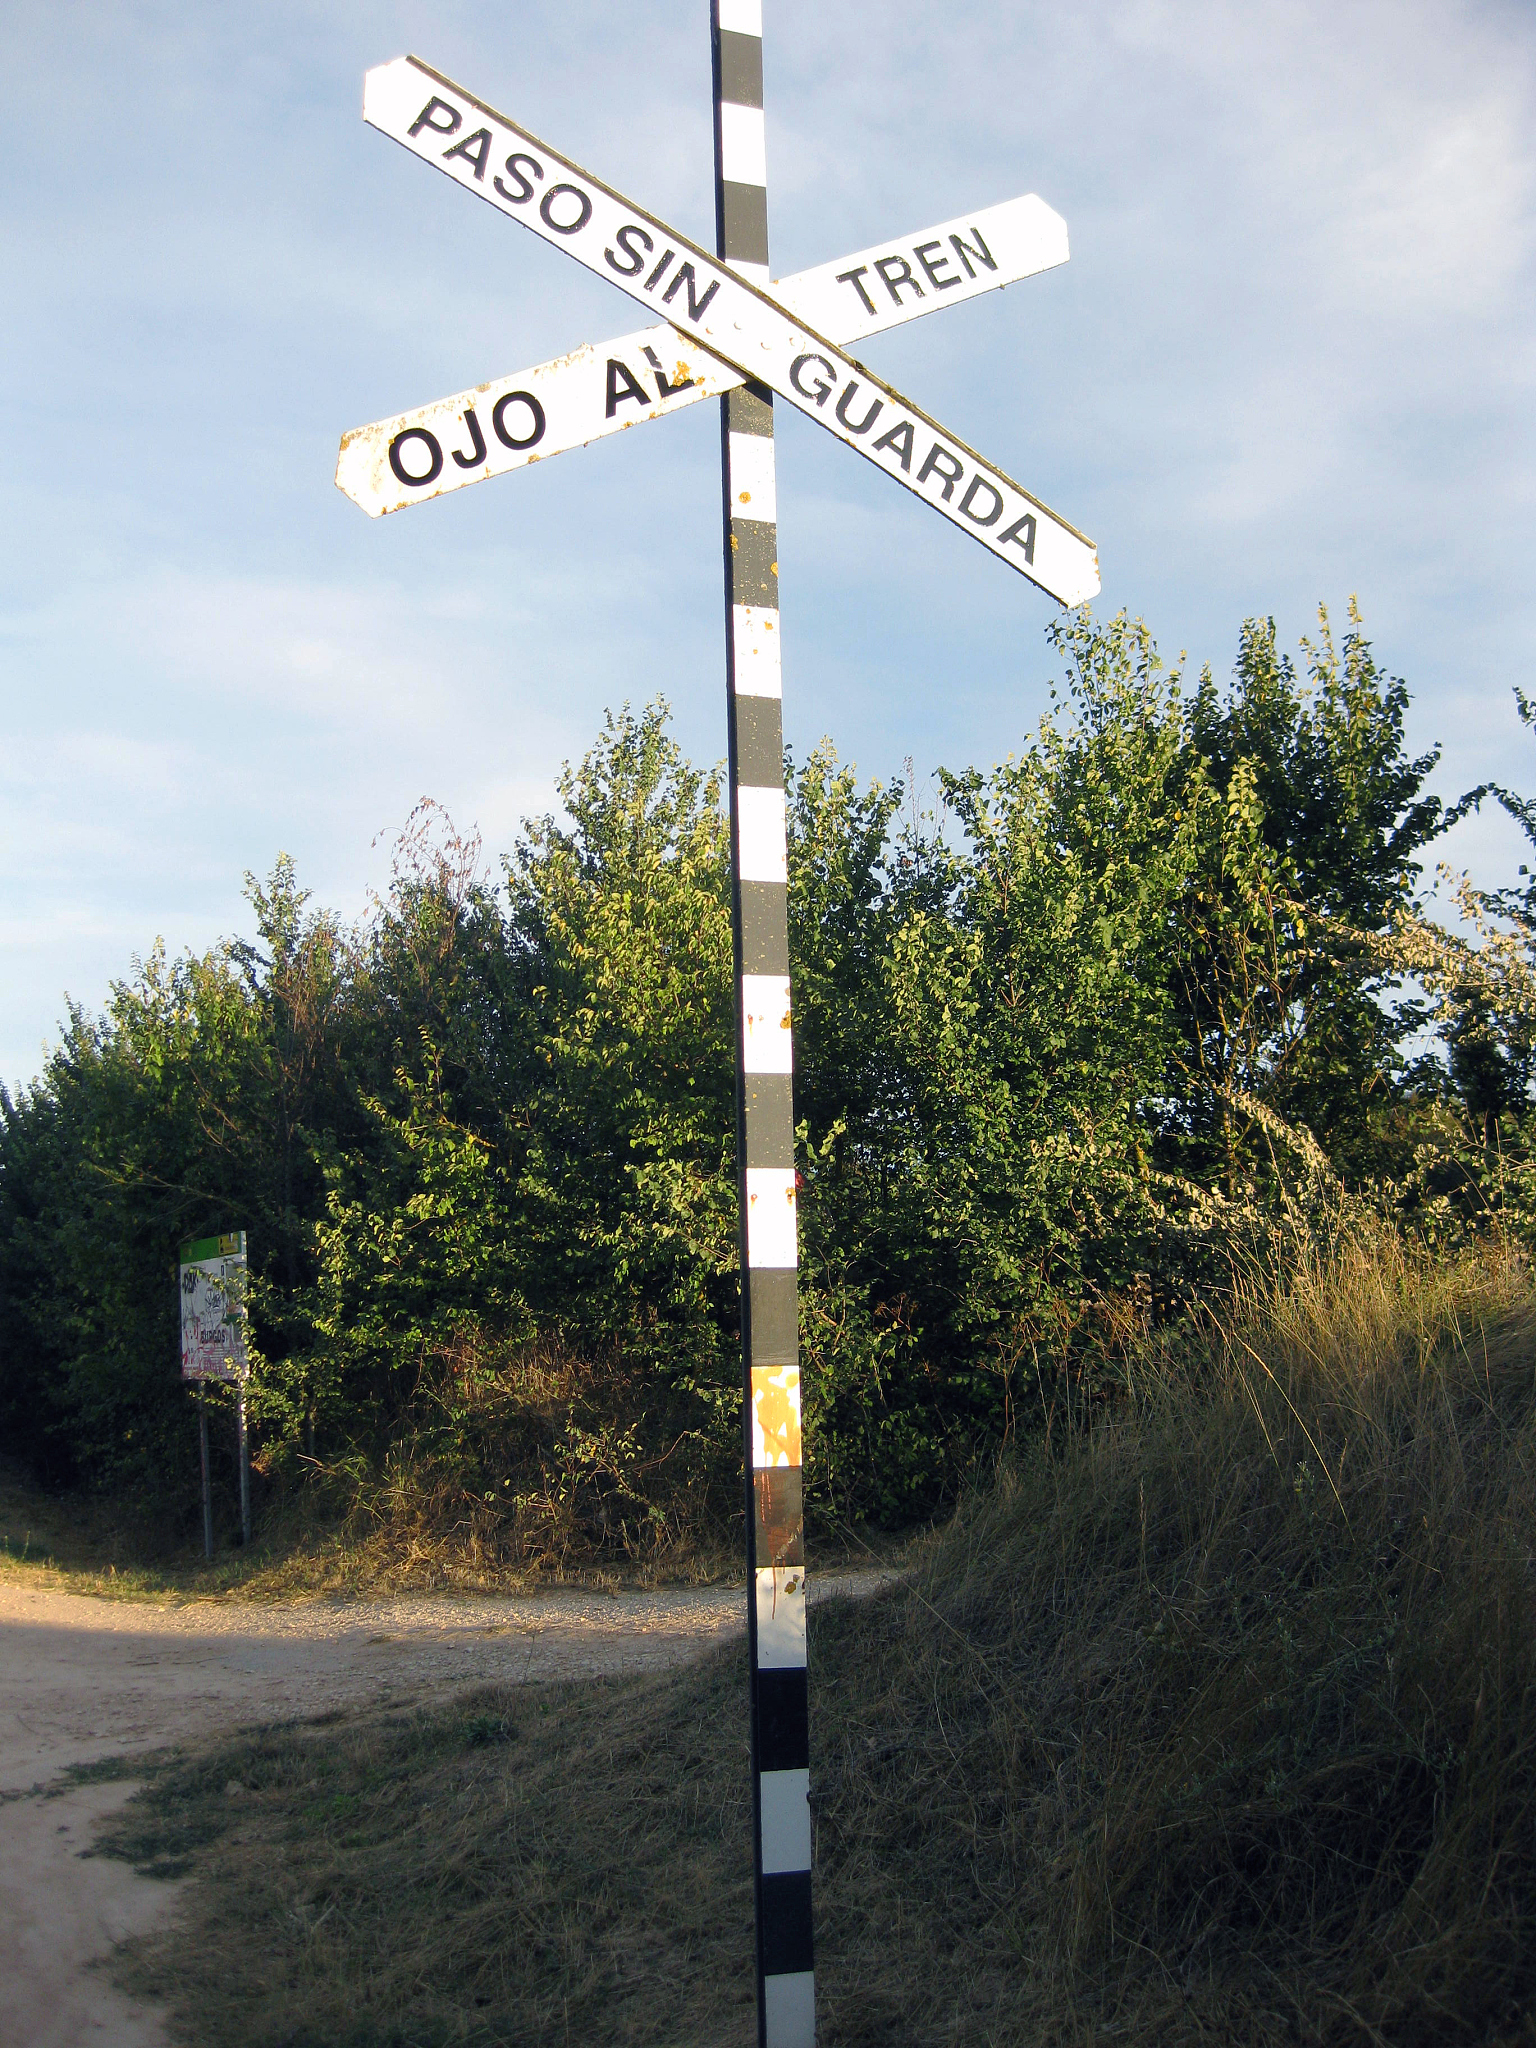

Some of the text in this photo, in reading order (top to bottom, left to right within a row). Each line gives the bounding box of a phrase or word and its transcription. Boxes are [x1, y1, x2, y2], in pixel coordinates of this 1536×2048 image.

[388, 227, 998, 487] OJO AL TREN
[407, 96, 1035, 565] PASO SIN GUARDA
